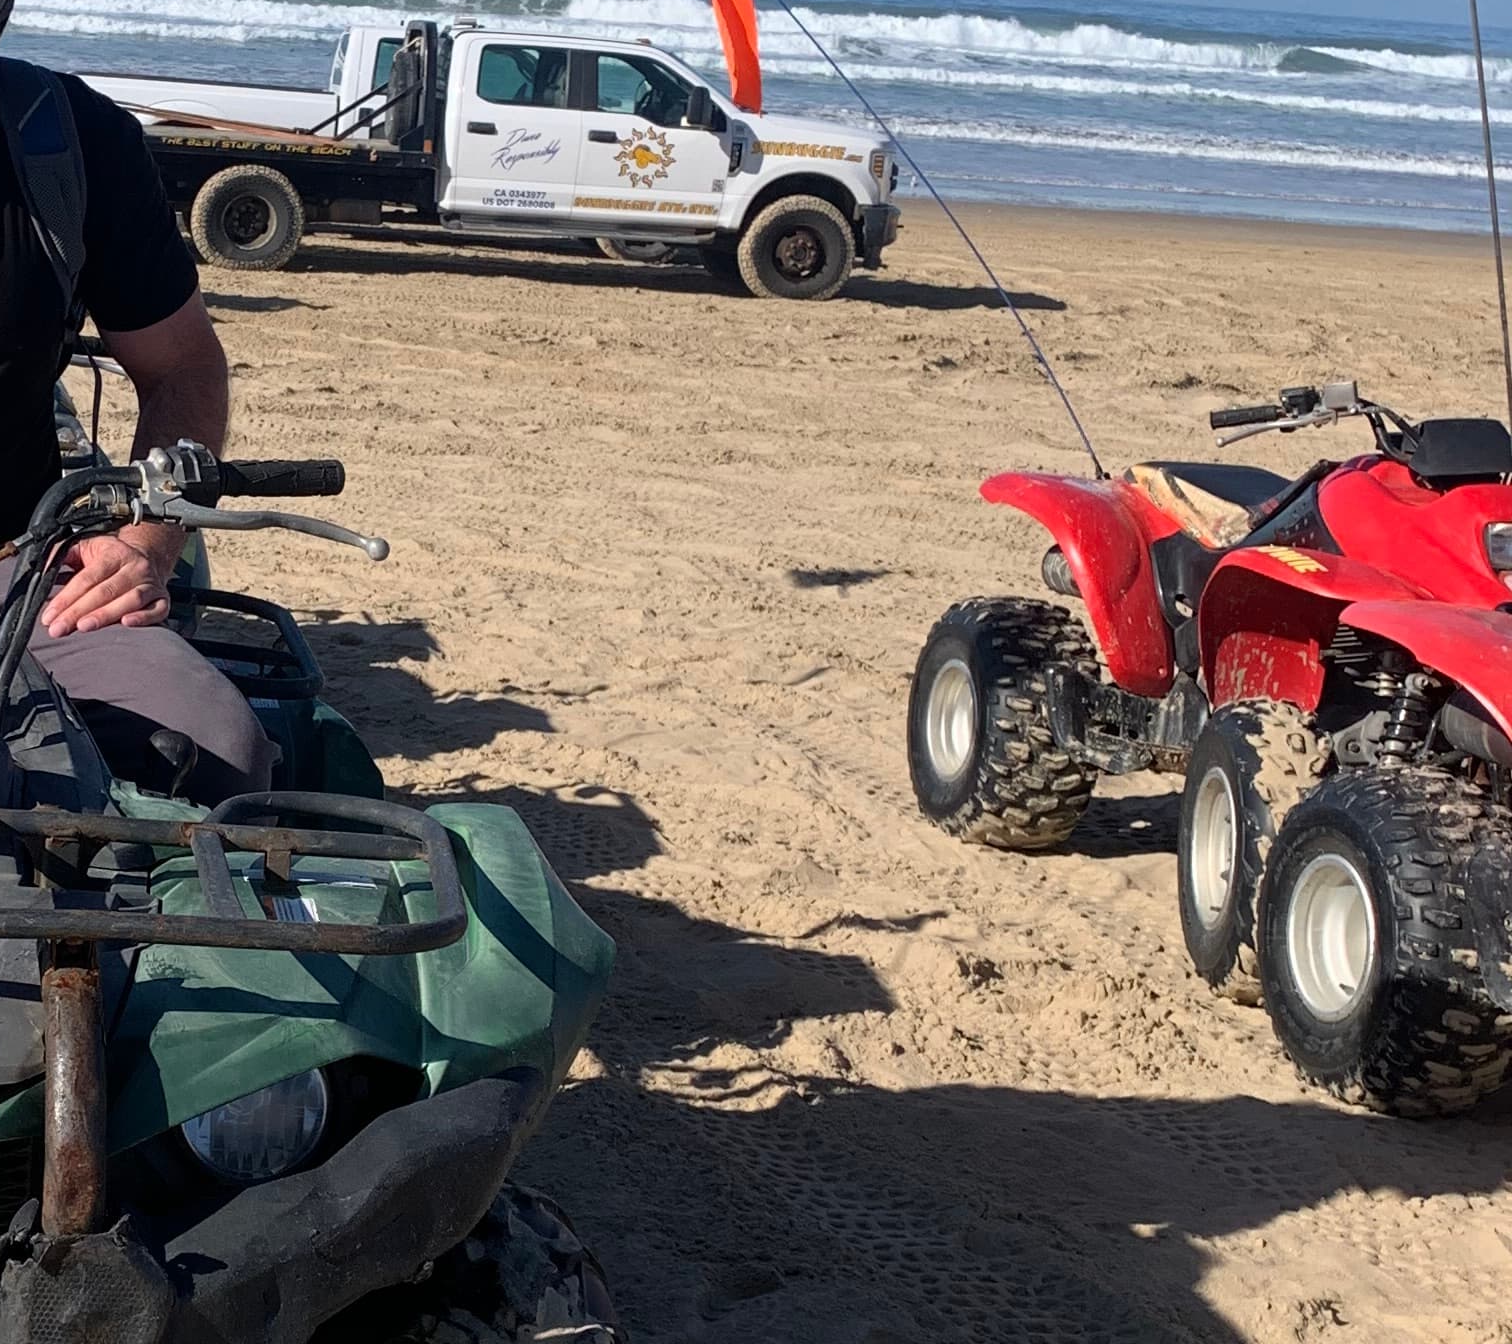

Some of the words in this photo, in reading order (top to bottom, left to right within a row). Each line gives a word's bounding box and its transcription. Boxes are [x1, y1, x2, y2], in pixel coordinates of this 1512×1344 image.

[160, 136, 184, 145] THE
[186, 138, 217, 148] BEST
[221, 140, 261, 150] STUFF
[264, 142, 281, 152] ON
[285, 144, 308, 154] THE
[310, 145, 353, 156] BEACH
[493, 188, 507, 197] CA
[481, 197, 495, 206] US
[496, 198, 515, 207] DOT
